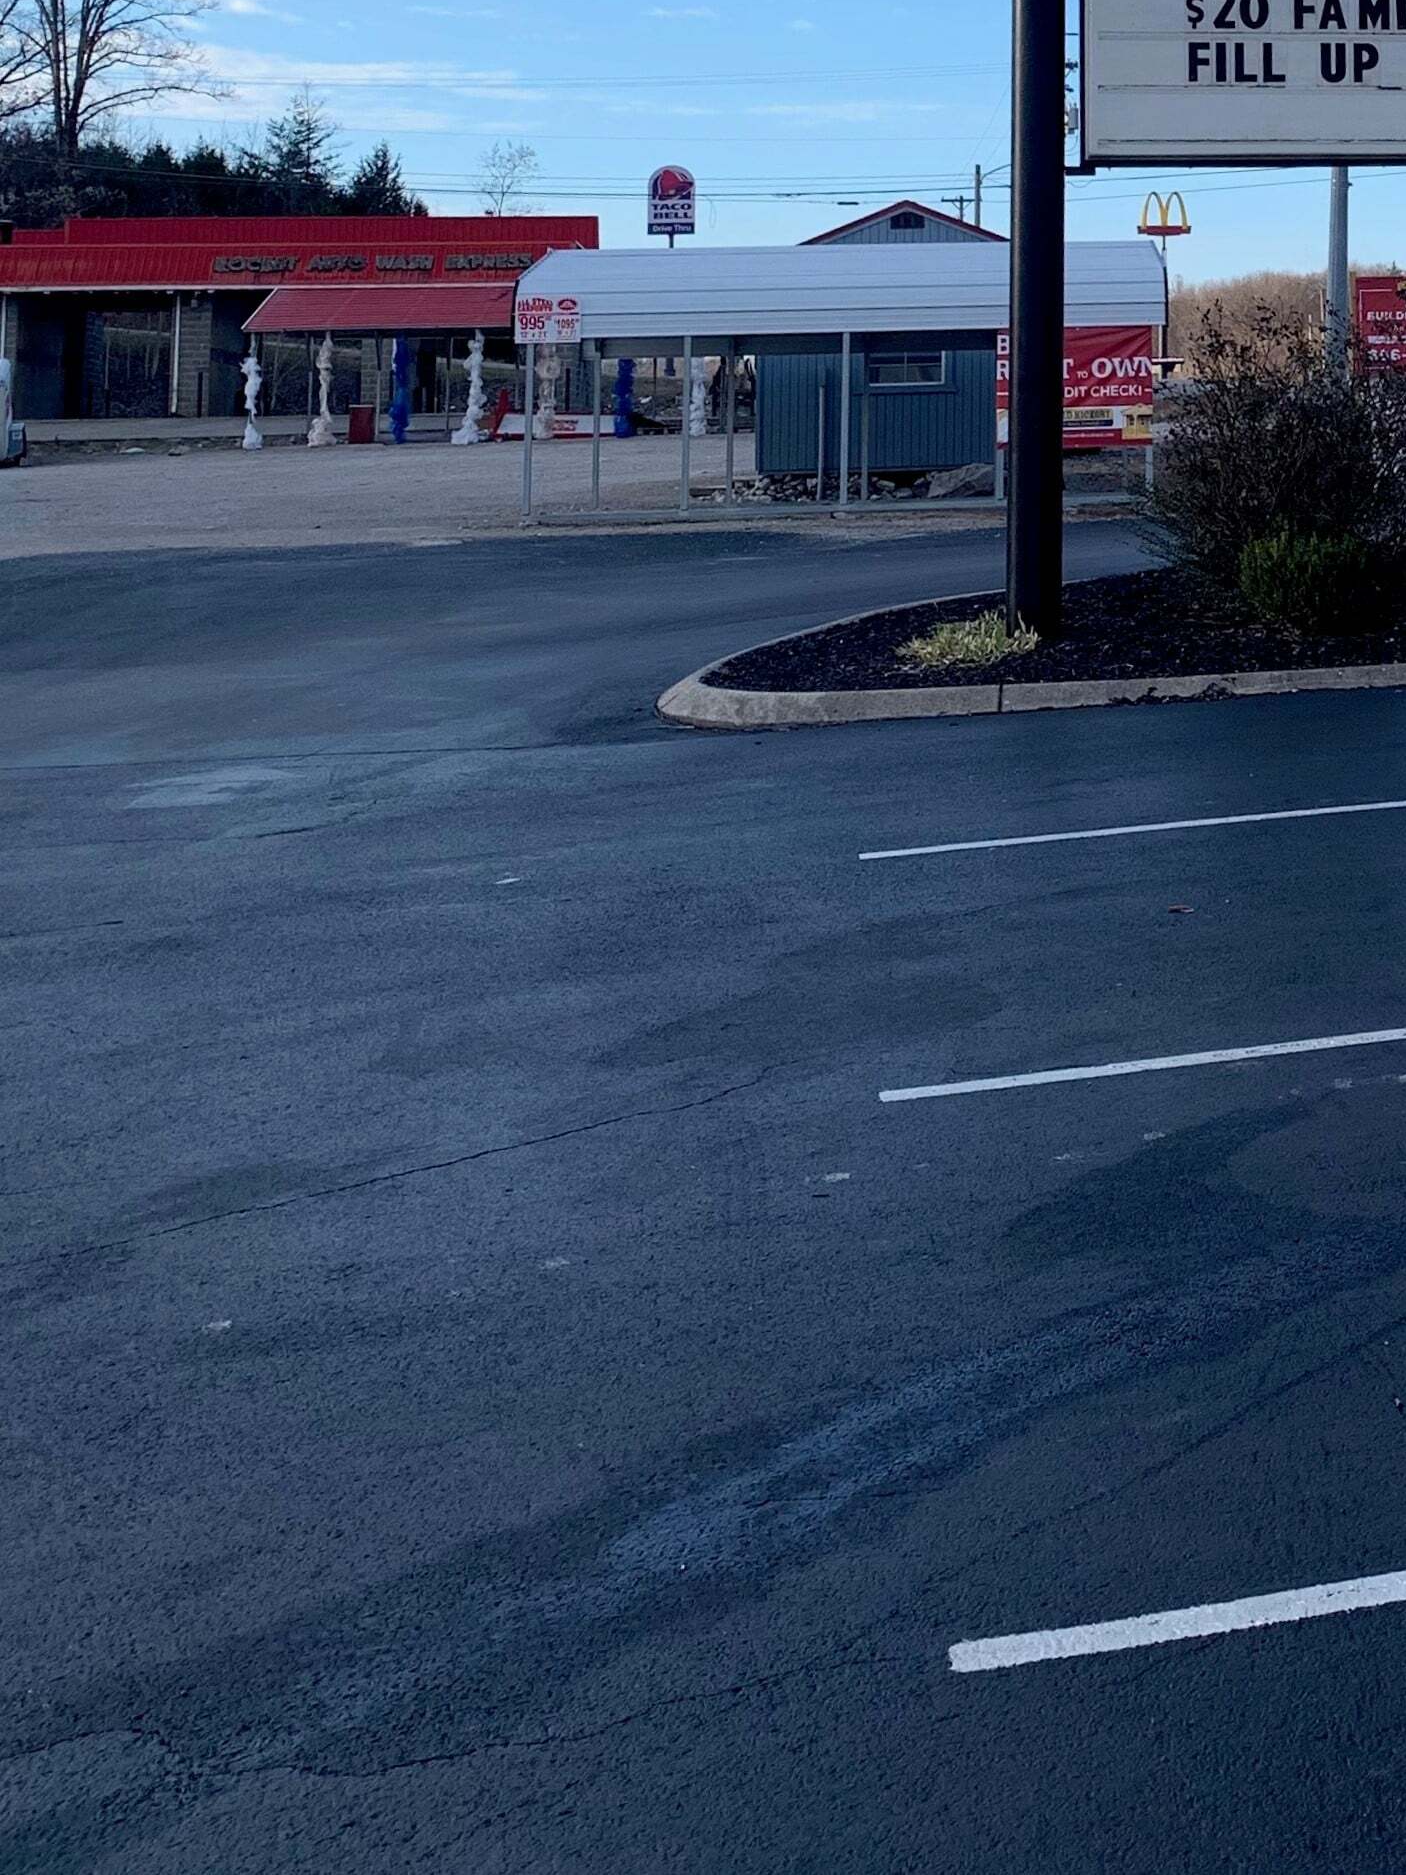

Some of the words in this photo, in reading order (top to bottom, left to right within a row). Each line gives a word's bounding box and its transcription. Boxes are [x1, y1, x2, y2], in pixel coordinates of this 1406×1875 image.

[1188, 42, 1286, 83] FILL
[1320, 42, 1380, 83] UP
[651, 203, 692, 211] TACO
[653, 211, 693, 220] BELL
[375, 254, 435, 270] WASH
[443, 253, 534, 270] EXPRESS
[1077, 370, 1089, 380] TO
[1091, 356, 1153, 379] OWN
